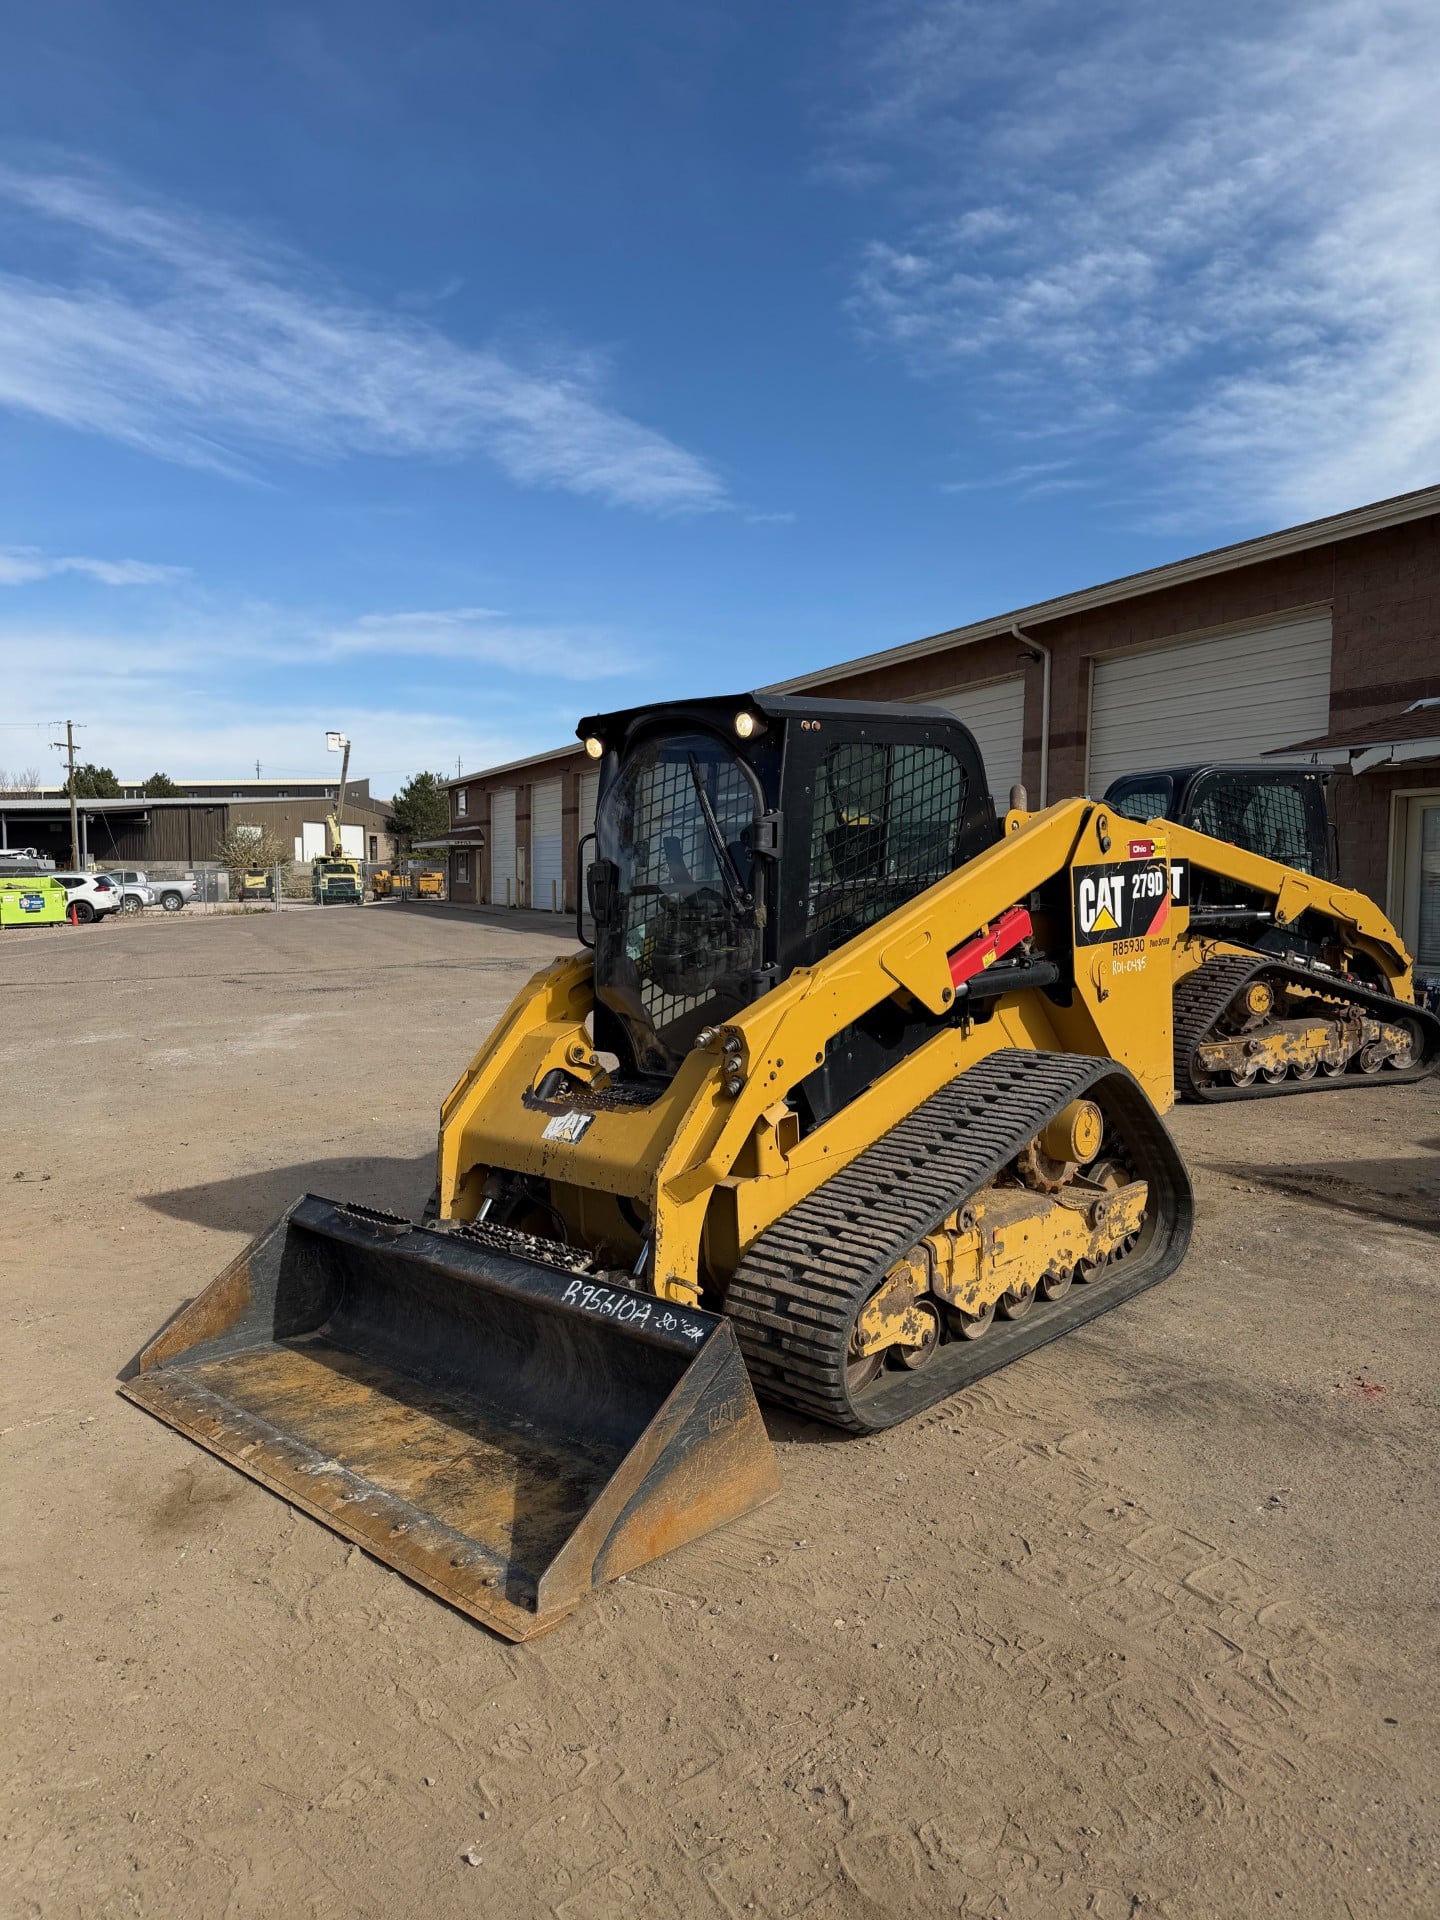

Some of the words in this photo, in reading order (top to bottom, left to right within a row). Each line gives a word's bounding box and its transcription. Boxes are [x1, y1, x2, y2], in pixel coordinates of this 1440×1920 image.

[1132, 844, 1147, 853] Ohio
[1079, 875, 1125, 933] CAT
[1132, 871, 1164, 899] 279D
[1112, 938, 1145, 956] R85930
